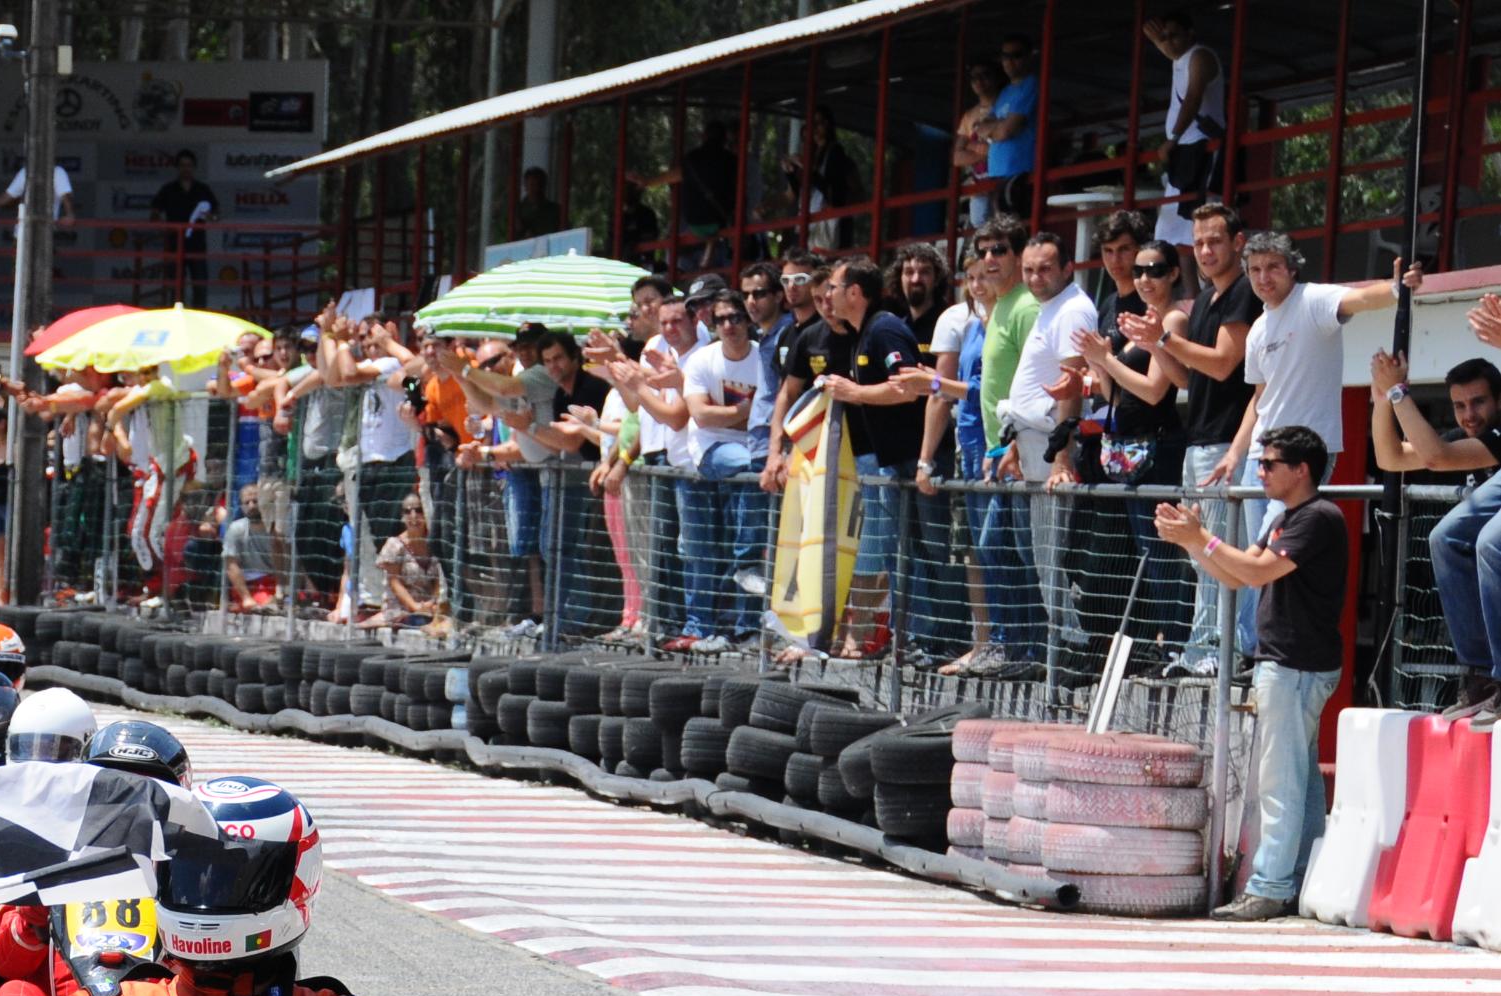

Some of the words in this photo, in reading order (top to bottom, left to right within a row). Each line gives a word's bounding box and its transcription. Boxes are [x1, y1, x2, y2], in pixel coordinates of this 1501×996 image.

[235, 192, 290, 206] HELIX
[117, 747, 150, 758] HJC
[83, 899, 141, 929] 88
[171, 934, 232, 955] Havoline
